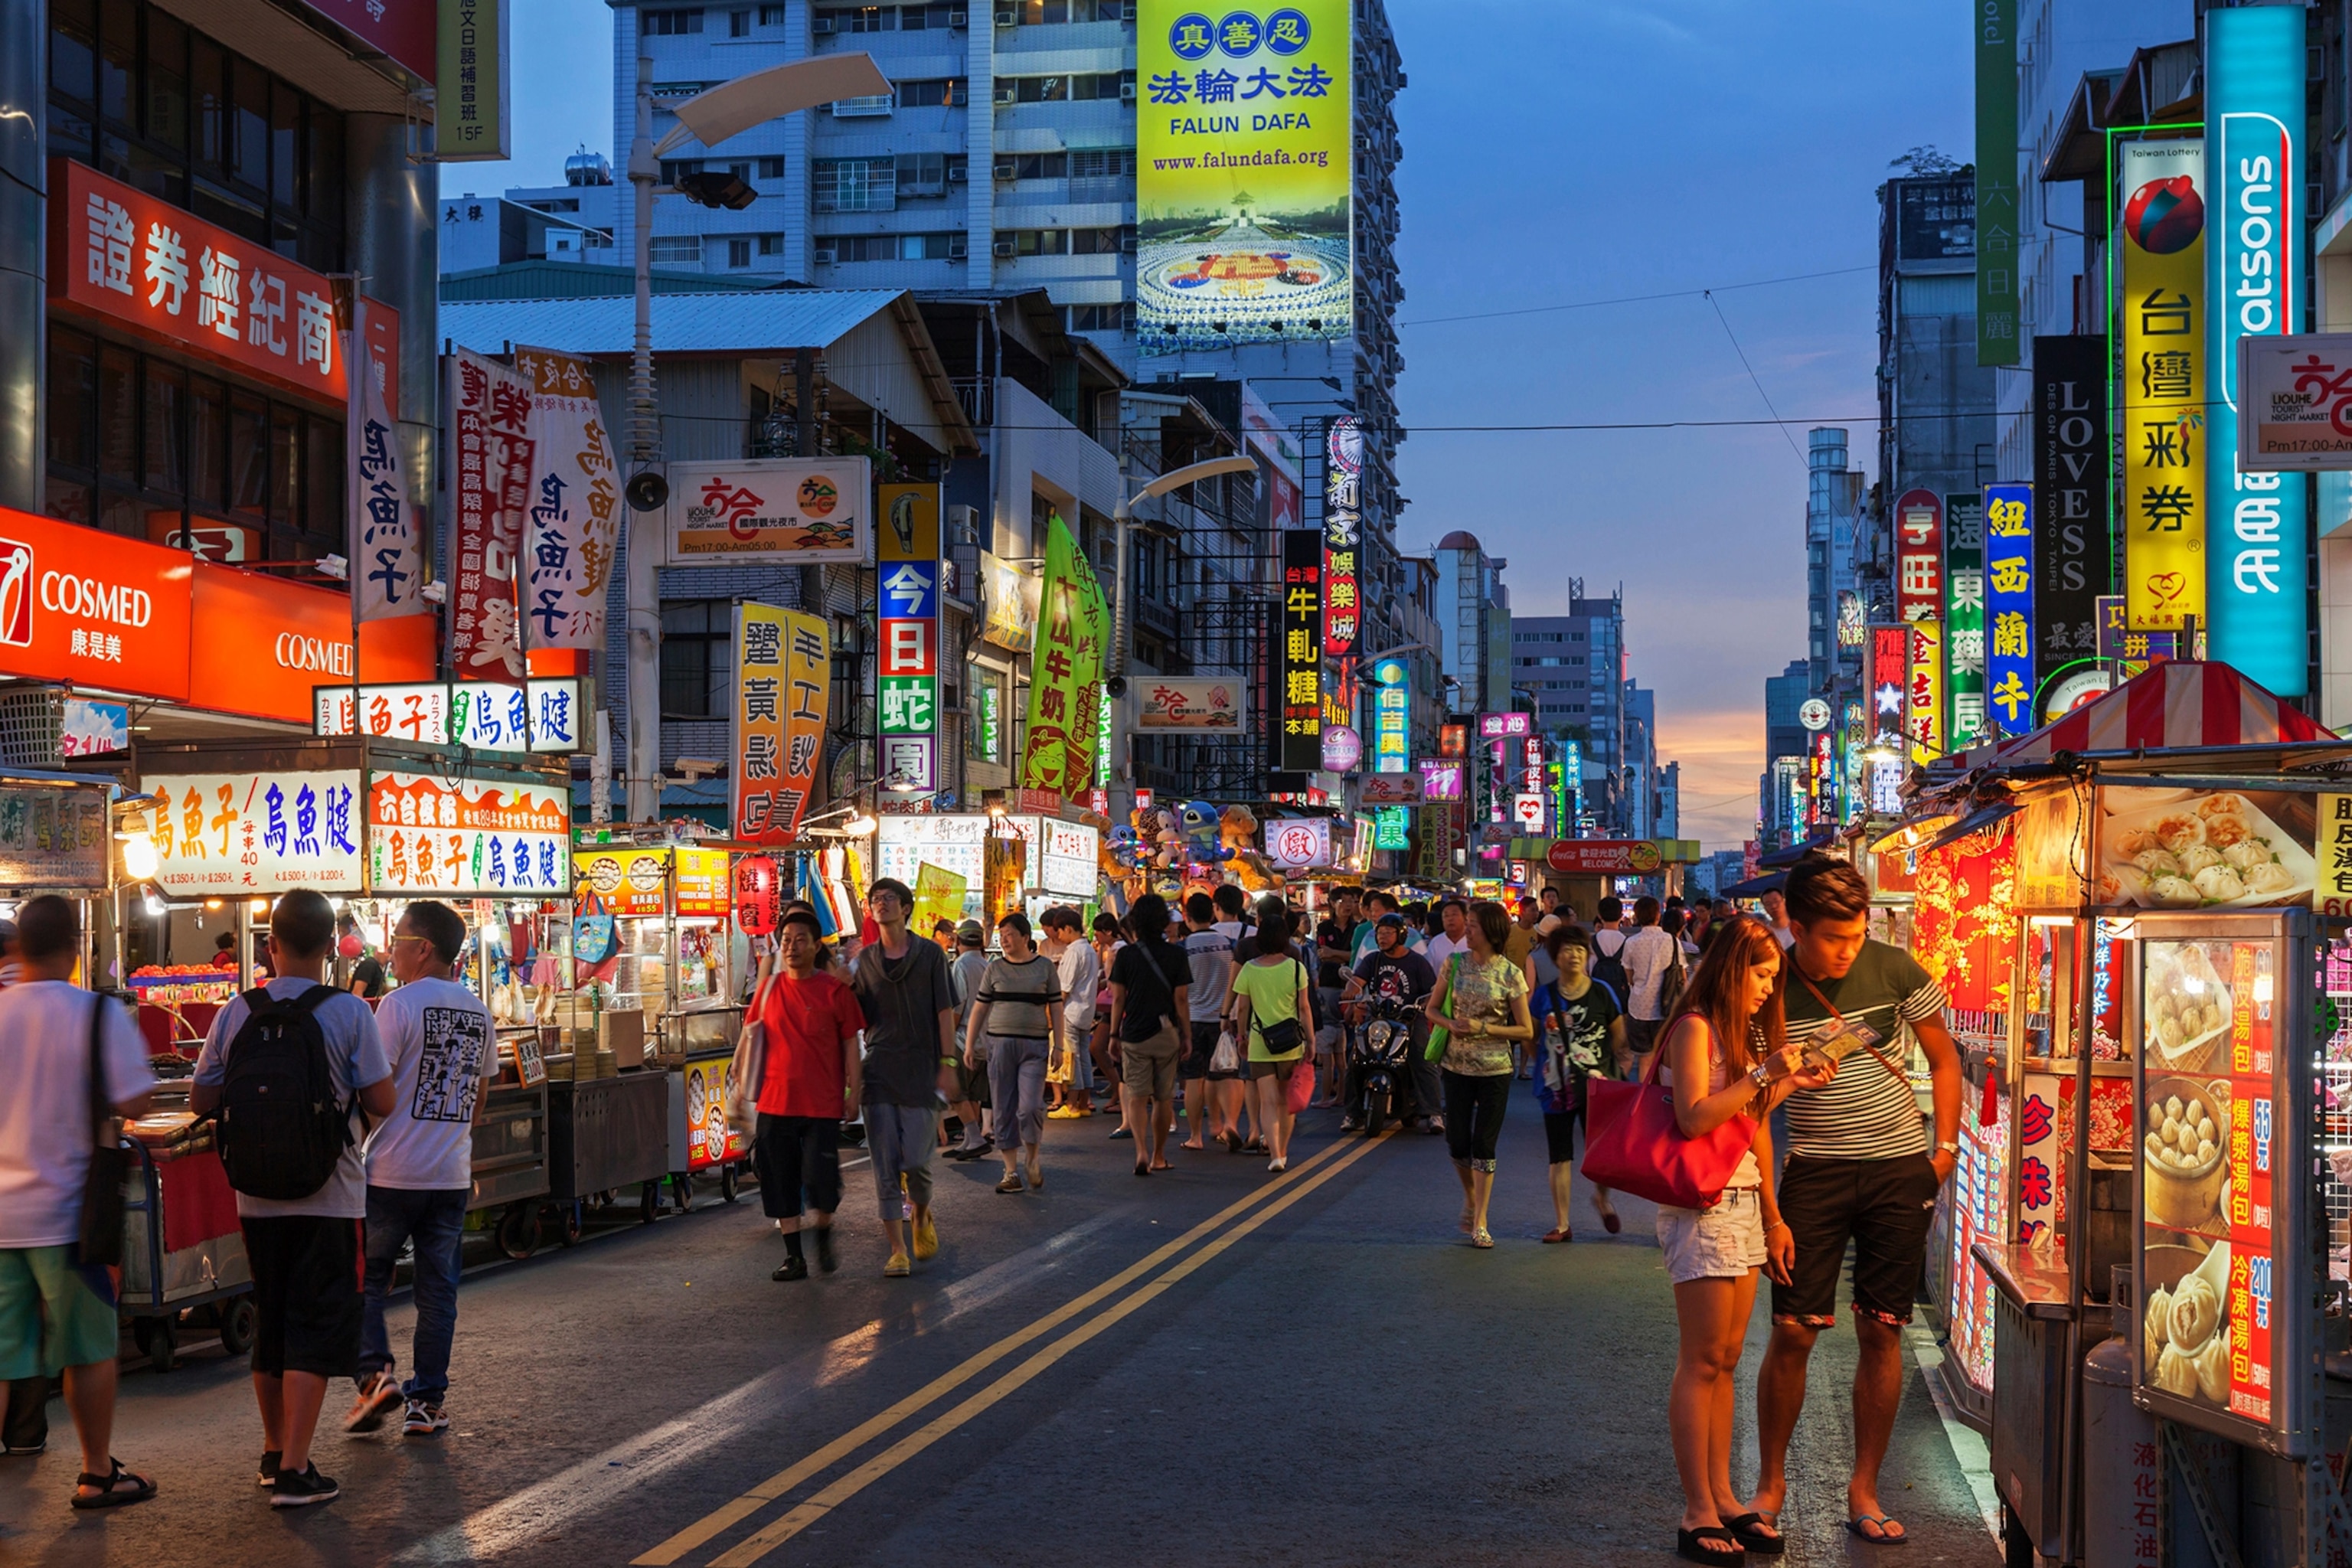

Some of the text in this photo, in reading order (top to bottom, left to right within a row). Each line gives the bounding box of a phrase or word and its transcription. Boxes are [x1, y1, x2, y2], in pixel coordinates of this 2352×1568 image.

[1175, 18, 1305, 51] 真善忍
[1148, 63, 1333, 105] 法輪大法
[457, 126, 483, 140] 15F
[1170, 113, 1311, 136] FALUN DAFA
[1153, 149, 1329, 171] www.falundafa.org
[2133, 148, 2201, 158] Taiwan Lottery
[1983, 181, 2014, 340] 六合日麗
[2236, 155, 2272, 338] atsons
[86, 191, 334, 377] 證券經紀商
[2141, 288, 2194, 531] 台灣彩券
[2271, 405, 2305, 413] TOURIST
[2272, 393, 2312, 405] LIOUHE
[2299, 413, 2329, 421] MARKET
[2047, 440, 2056, 488] PARIS
[2060, 381, 2093, 592] LOVESS
[688, 507, 716, 517] LIOUHE
[739, 517, 798, 528] 國際觀光夜市
[2047, 492, 2056, 538] TOKYO
[684, 541, 776, 552] Pm17:00-Am05:00
[2047, 547, 2056, 591] TAIPEI
[1285, 567, 1319, 583] 台灣
[1330, 552, 1355, 640] 娛樂城
[41, 570, 152, 628] COSMED
[1949, 503, 1984, 740] 遠東藥局
[1988, 497, 2030, 721] 紐西蘭牛
[70, 628, 122, 663] 康是美
[275, 632, 354, 677] COSMED
[1287, 587, 1318, 704] 牛軋糖
[2043, 621, 2097, 650] 最愛
[2044, 652, 2075, 661] SINCE
[882, 564, 933, 789] 今日蛇園
[1285, 720, 1319, 735] 本舖
[149, 783, 240, 861] 烏魚子
[263, 782, 357, 858] 烏魚腱
[378, 789, 458, 828] 六合夜市
[387, 829, 468, 887] 烏魚子
[1582, 859, 1616, 868] WELCOME
[2233, 947, 2251, 1073] 脆皮湯包
[2253, 1098, 2272, 1171] 55元
[2232, 1099, 2250, 1226] 爆漿湯包
[2250, 1256, 2272, 1329] 200元
[2231, 1255, 2249, 1384] 冷凍湯包
